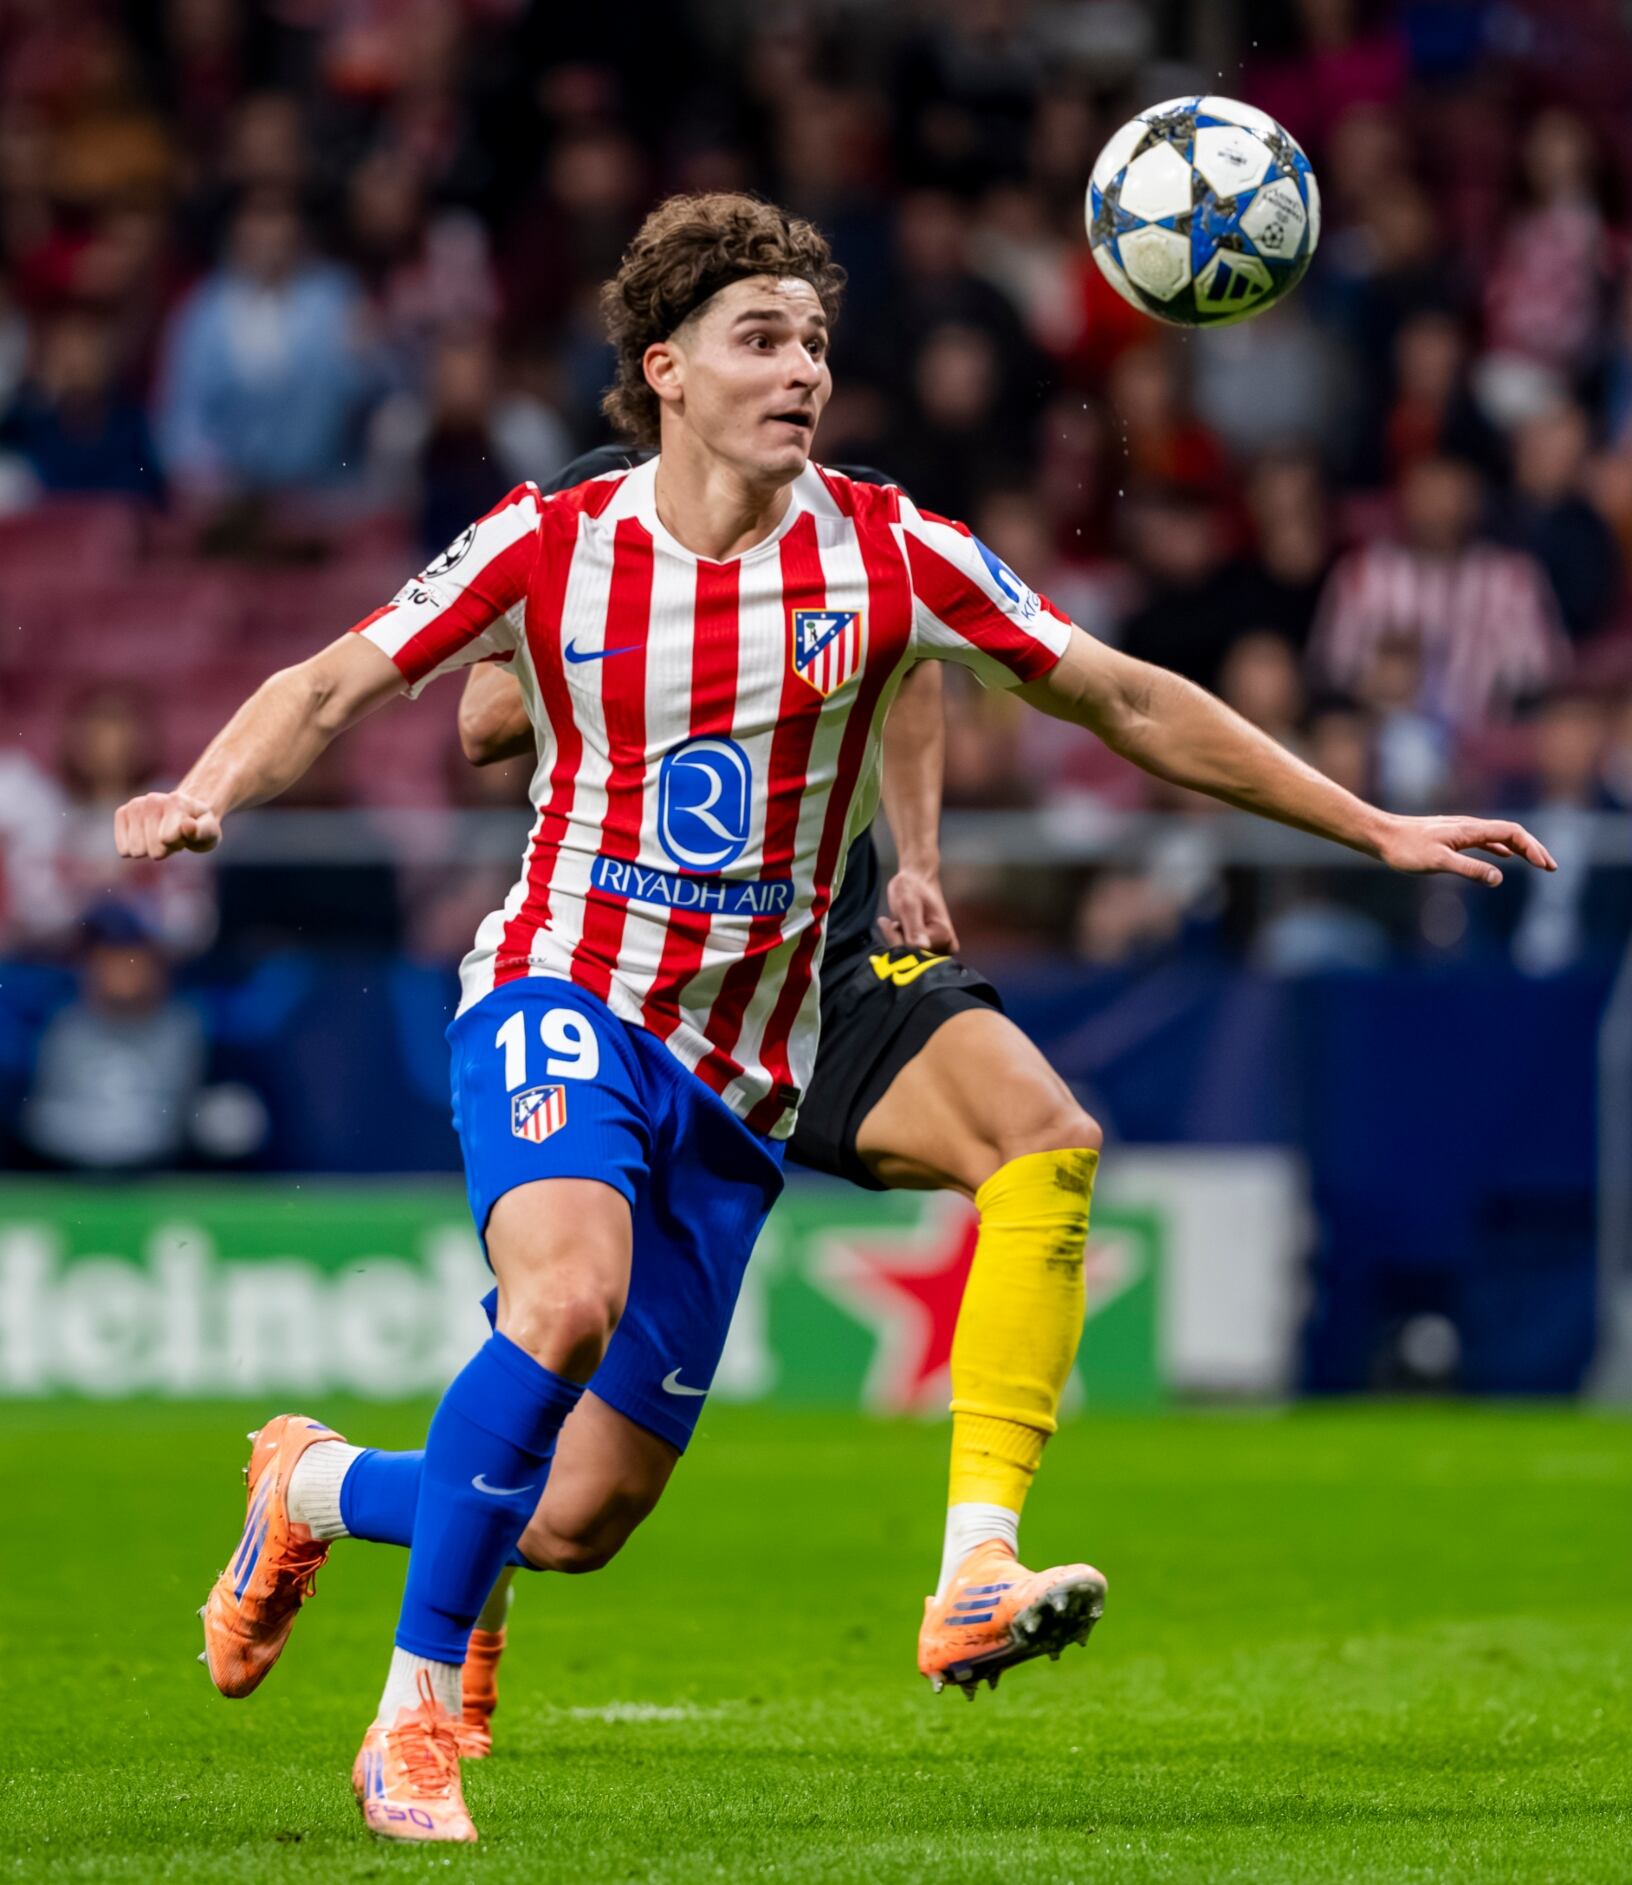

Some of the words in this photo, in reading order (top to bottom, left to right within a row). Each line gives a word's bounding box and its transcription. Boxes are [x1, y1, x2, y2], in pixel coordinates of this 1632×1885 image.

[599, 858, 727, 911] RIYADH
[734, 883, 788, 913] AIR
[495, 1008, 600, 1093] 19
